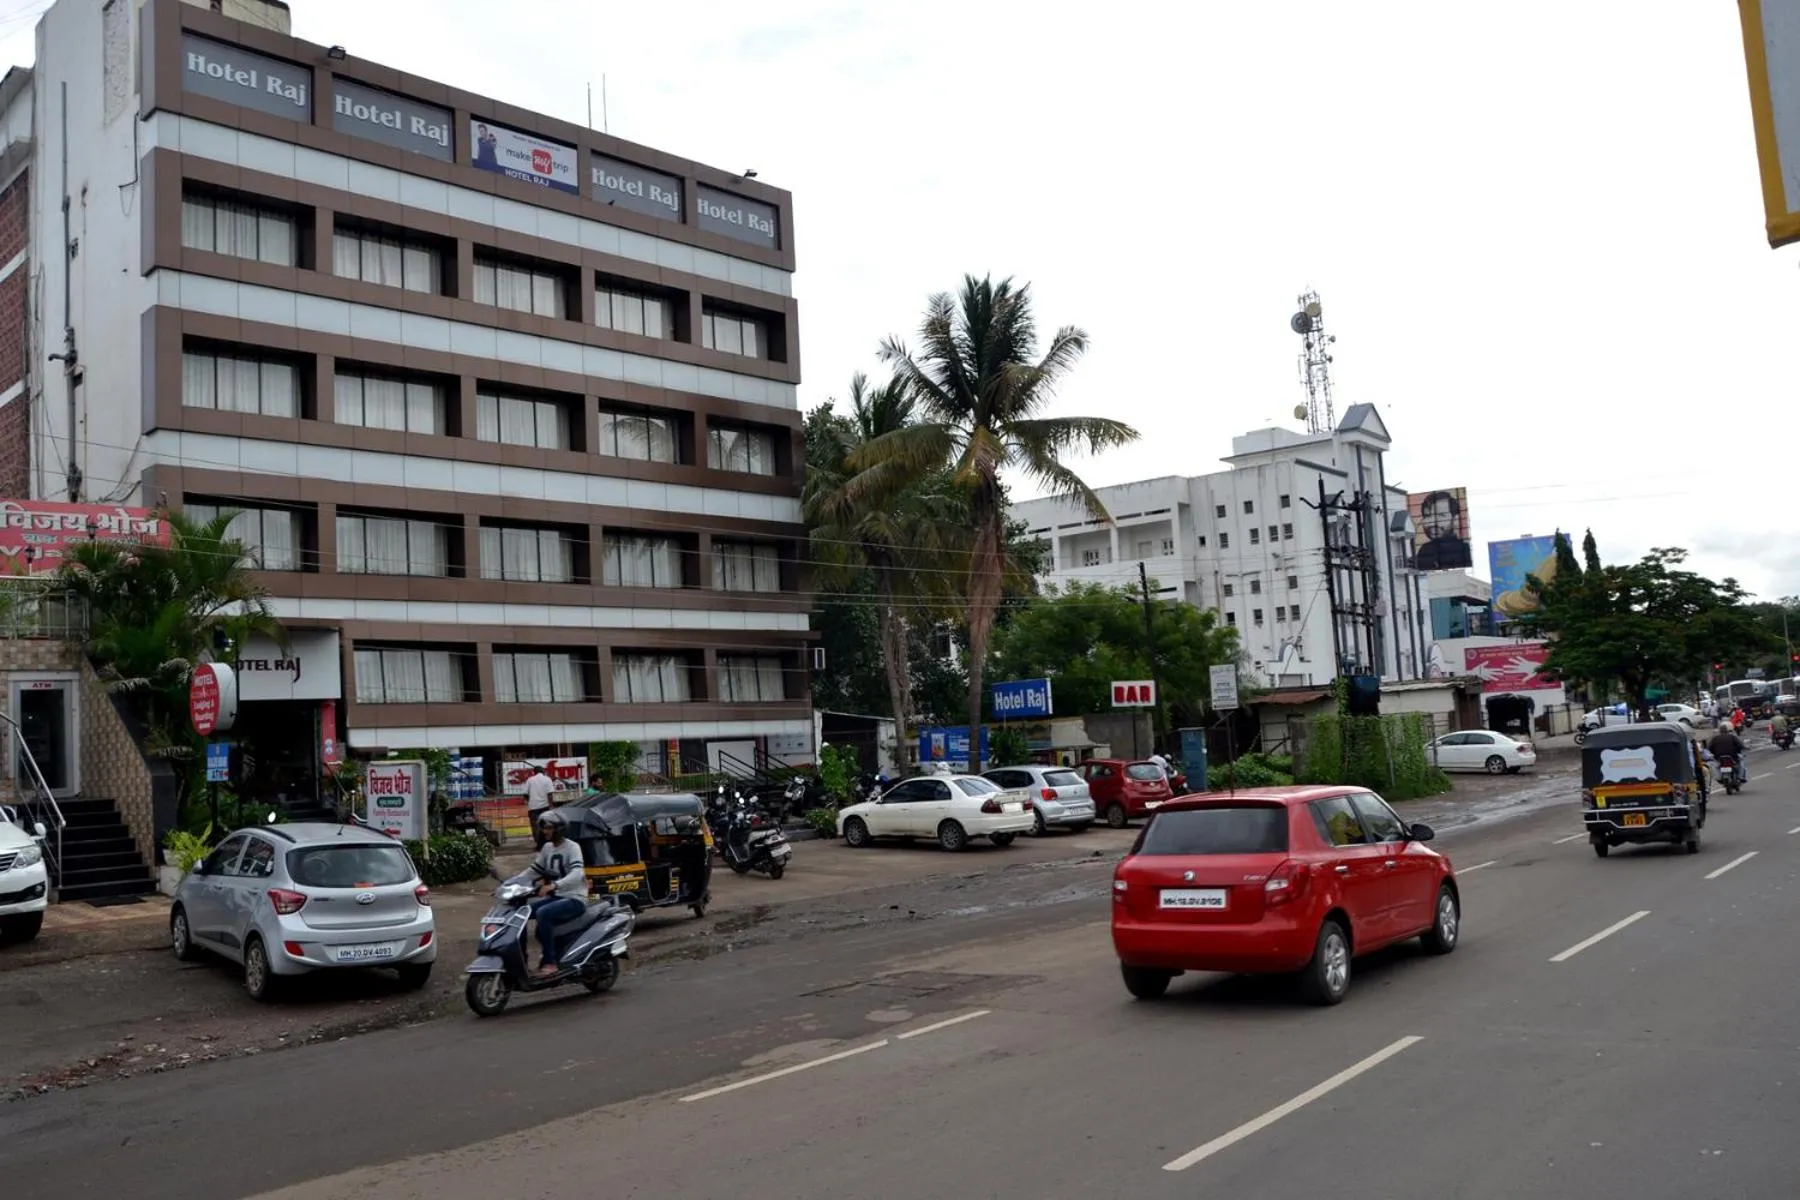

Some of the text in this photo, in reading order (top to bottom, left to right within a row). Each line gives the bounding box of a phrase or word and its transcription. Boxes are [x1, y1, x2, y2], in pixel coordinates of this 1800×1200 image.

[187, 52, 306, 106] Hotel Raj
[335, 94, 449, 146] Hotel Raj
[504, 168, 549, 187] HOTEL RAJ
[592, 167, 679, 212] Hotel Raj
[697, 198, 775, 238] Hotel Raj
[0, 501, 159, 536] विजय भोज
[236, 657, 300, 683] OTEL RAJ
[994, 688, 1046, 712] Hotel Raj
[1114, 685, 1151, 703] BAR
[369, 768, 411, 795] विजय भोज
